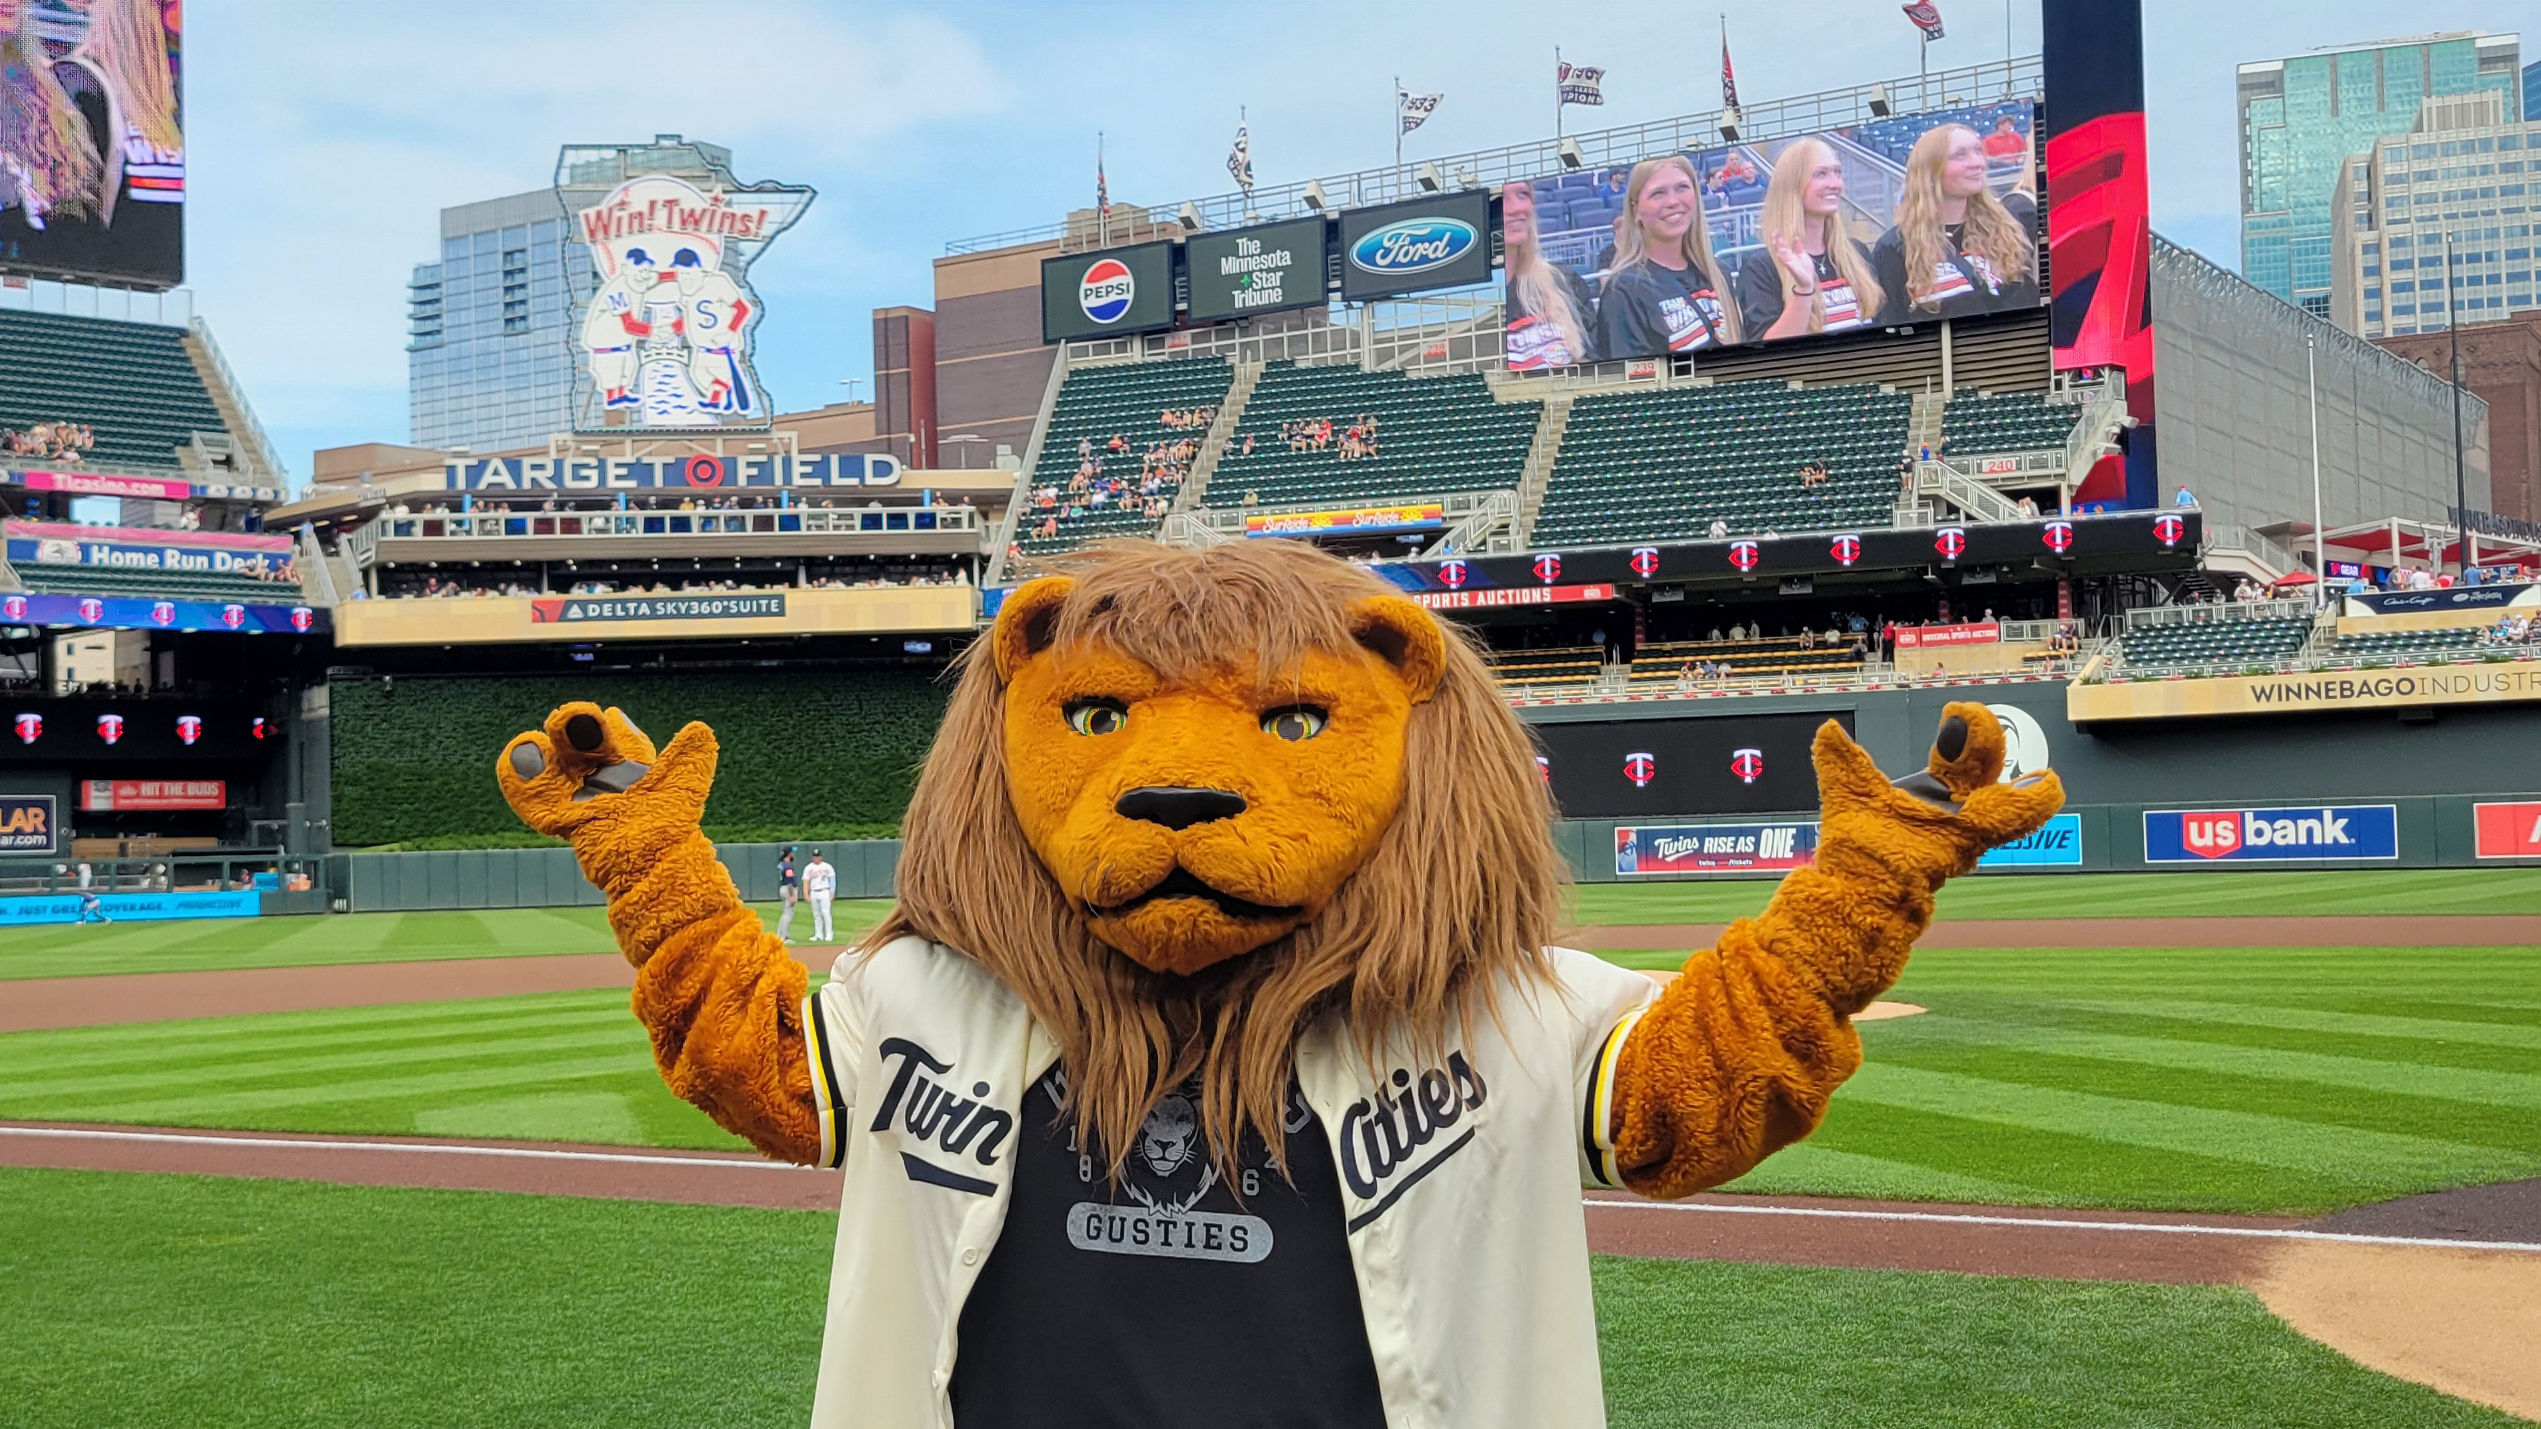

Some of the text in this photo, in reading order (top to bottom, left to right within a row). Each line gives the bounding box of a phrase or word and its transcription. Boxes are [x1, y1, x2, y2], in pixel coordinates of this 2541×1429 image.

[583, 198, 769, 241] Win! Twins!
[1236, 237, 1261, 256] The
[1375, 227, 1452, 266] Ford
[1221, 249, 1292, 275] Minnesota
[1084, 282, 1131, 301] PEPSI
[1252, 270, 1284, 290] Star
[608, 292, 629, 310] M
[1232, 287, 1283, 309] Tribune
[696, 300, 718, 329] S
[445, 453, 903, 490] TARGET FIELD
[1988, 460, 2013, 472] 240
[1263, 518, 1309, 533] Surfside
[1352, 512, 1399, 527] Surfside
[92, 545, 160, 569] Home
[164, 549, 209, 570] Run
[587, 602, 651, 617] DELTA
[1414, 588, 1551, 608] SPORTS AUCTIONS
[2250, 677, 2416, 703] WINNEBAGO
[2188, 809, 2350, 848] us bank
[1654, 828, 1796, 862] Twins RISE AS ONE
[870, 1037, 1012, 1165] Twin
[1340, 1049, 1487, 1199] Cities
[1086, 1213, 1249, 1252] GUSTIES
